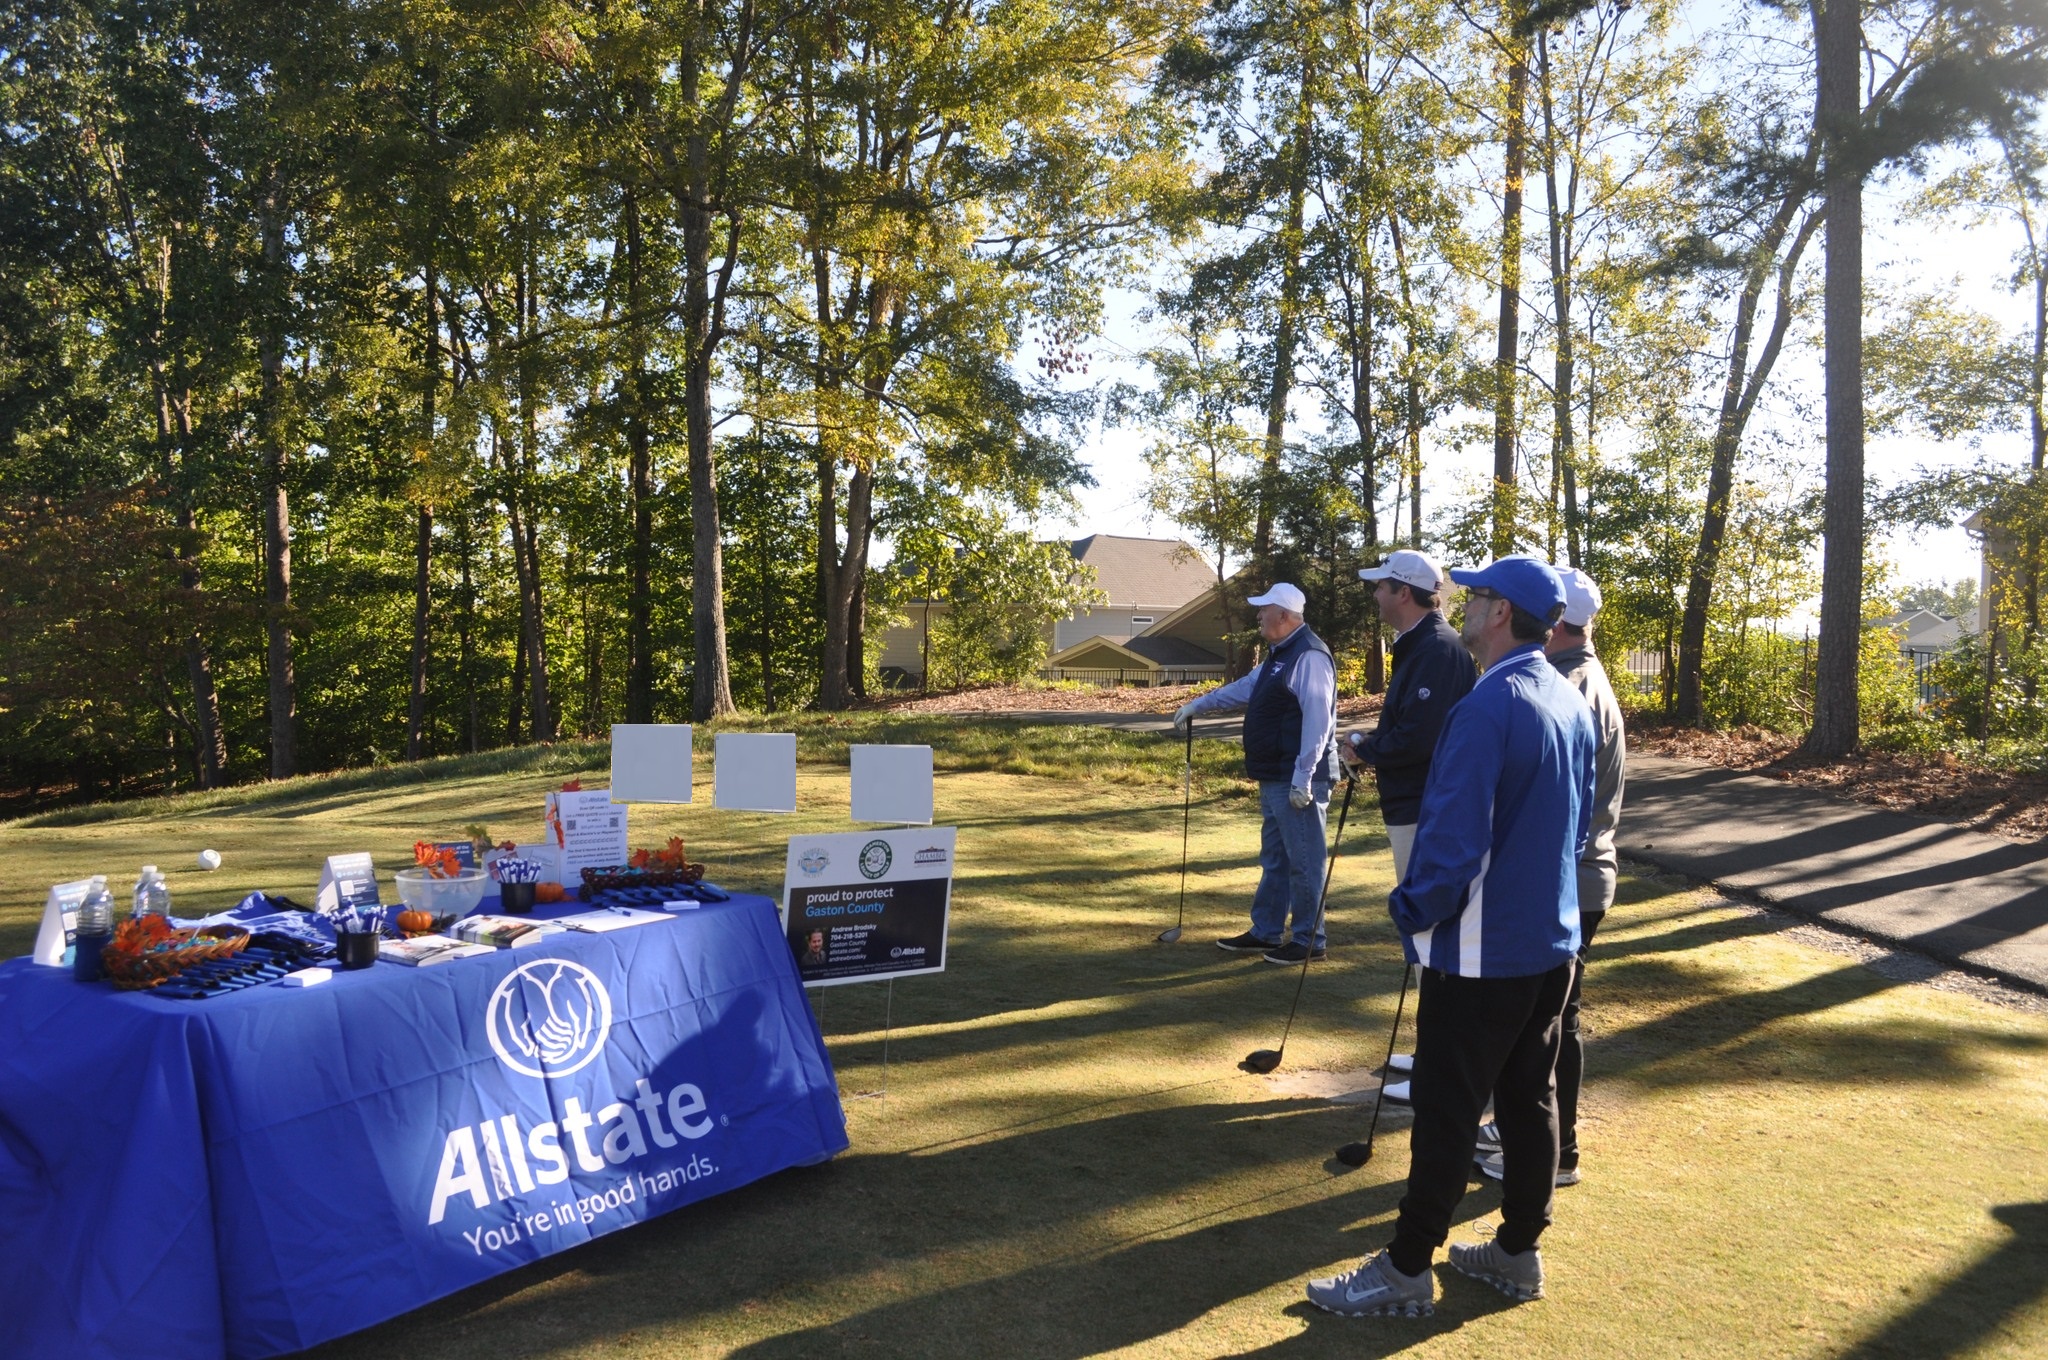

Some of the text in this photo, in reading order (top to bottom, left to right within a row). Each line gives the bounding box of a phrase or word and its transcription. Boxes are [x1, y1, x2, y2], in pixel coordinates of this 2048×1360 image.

[807, 887, 894, 905] proud to protect
[805, 902, 885, 917] Gaston County
[831, 923, 877, 933] Andrew Brodsky
[849, 939, 867, 947] County
[902, 946, 925, 956] Allstate
[428, 1078, 714, 1226] Allstate
[462, 1154, 720, 1257] You're in good hands.
